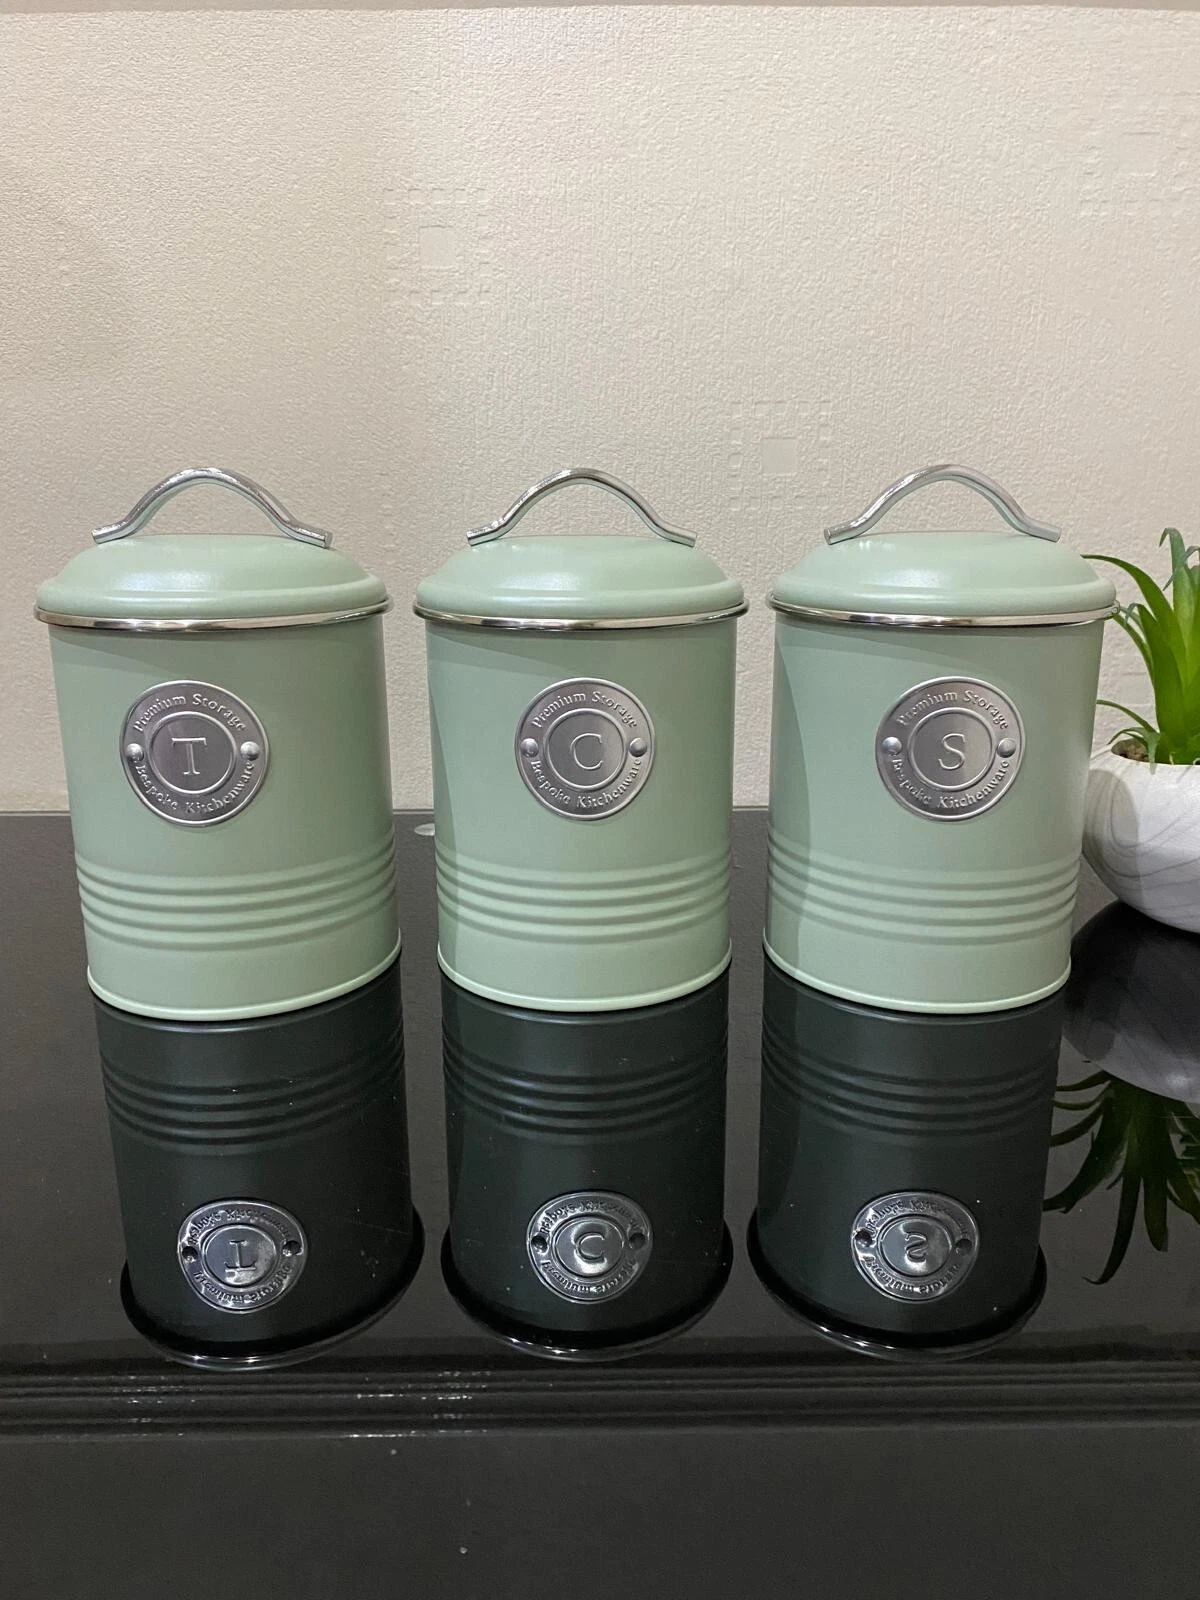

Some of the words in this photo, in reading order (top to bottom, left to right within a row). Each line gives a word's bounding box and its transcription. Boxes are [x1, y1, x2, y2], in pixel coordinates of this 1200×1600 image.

[133, 694, 187, 732] Premium
[192, 693, 246, 731] Storage
[532, 692, 586, 728] Premium
[591, 691, 637, 728] Storage
[897, 692, 958, 726] Premium
[963, 690, 1009, 730] Storage
[171, 737, 207, 775] T
[570, 732, 603, 770] C
[938, 733, 965, 770] S
[135, 763, 178, 810] Bespoke
[185, 761, 254, 814] Kitchenware
[530, 760, 571, 805] Bespoke
[576, 758, 642, 808] Kitchenware
[937, 760, 1009, 809] Kitchenware
